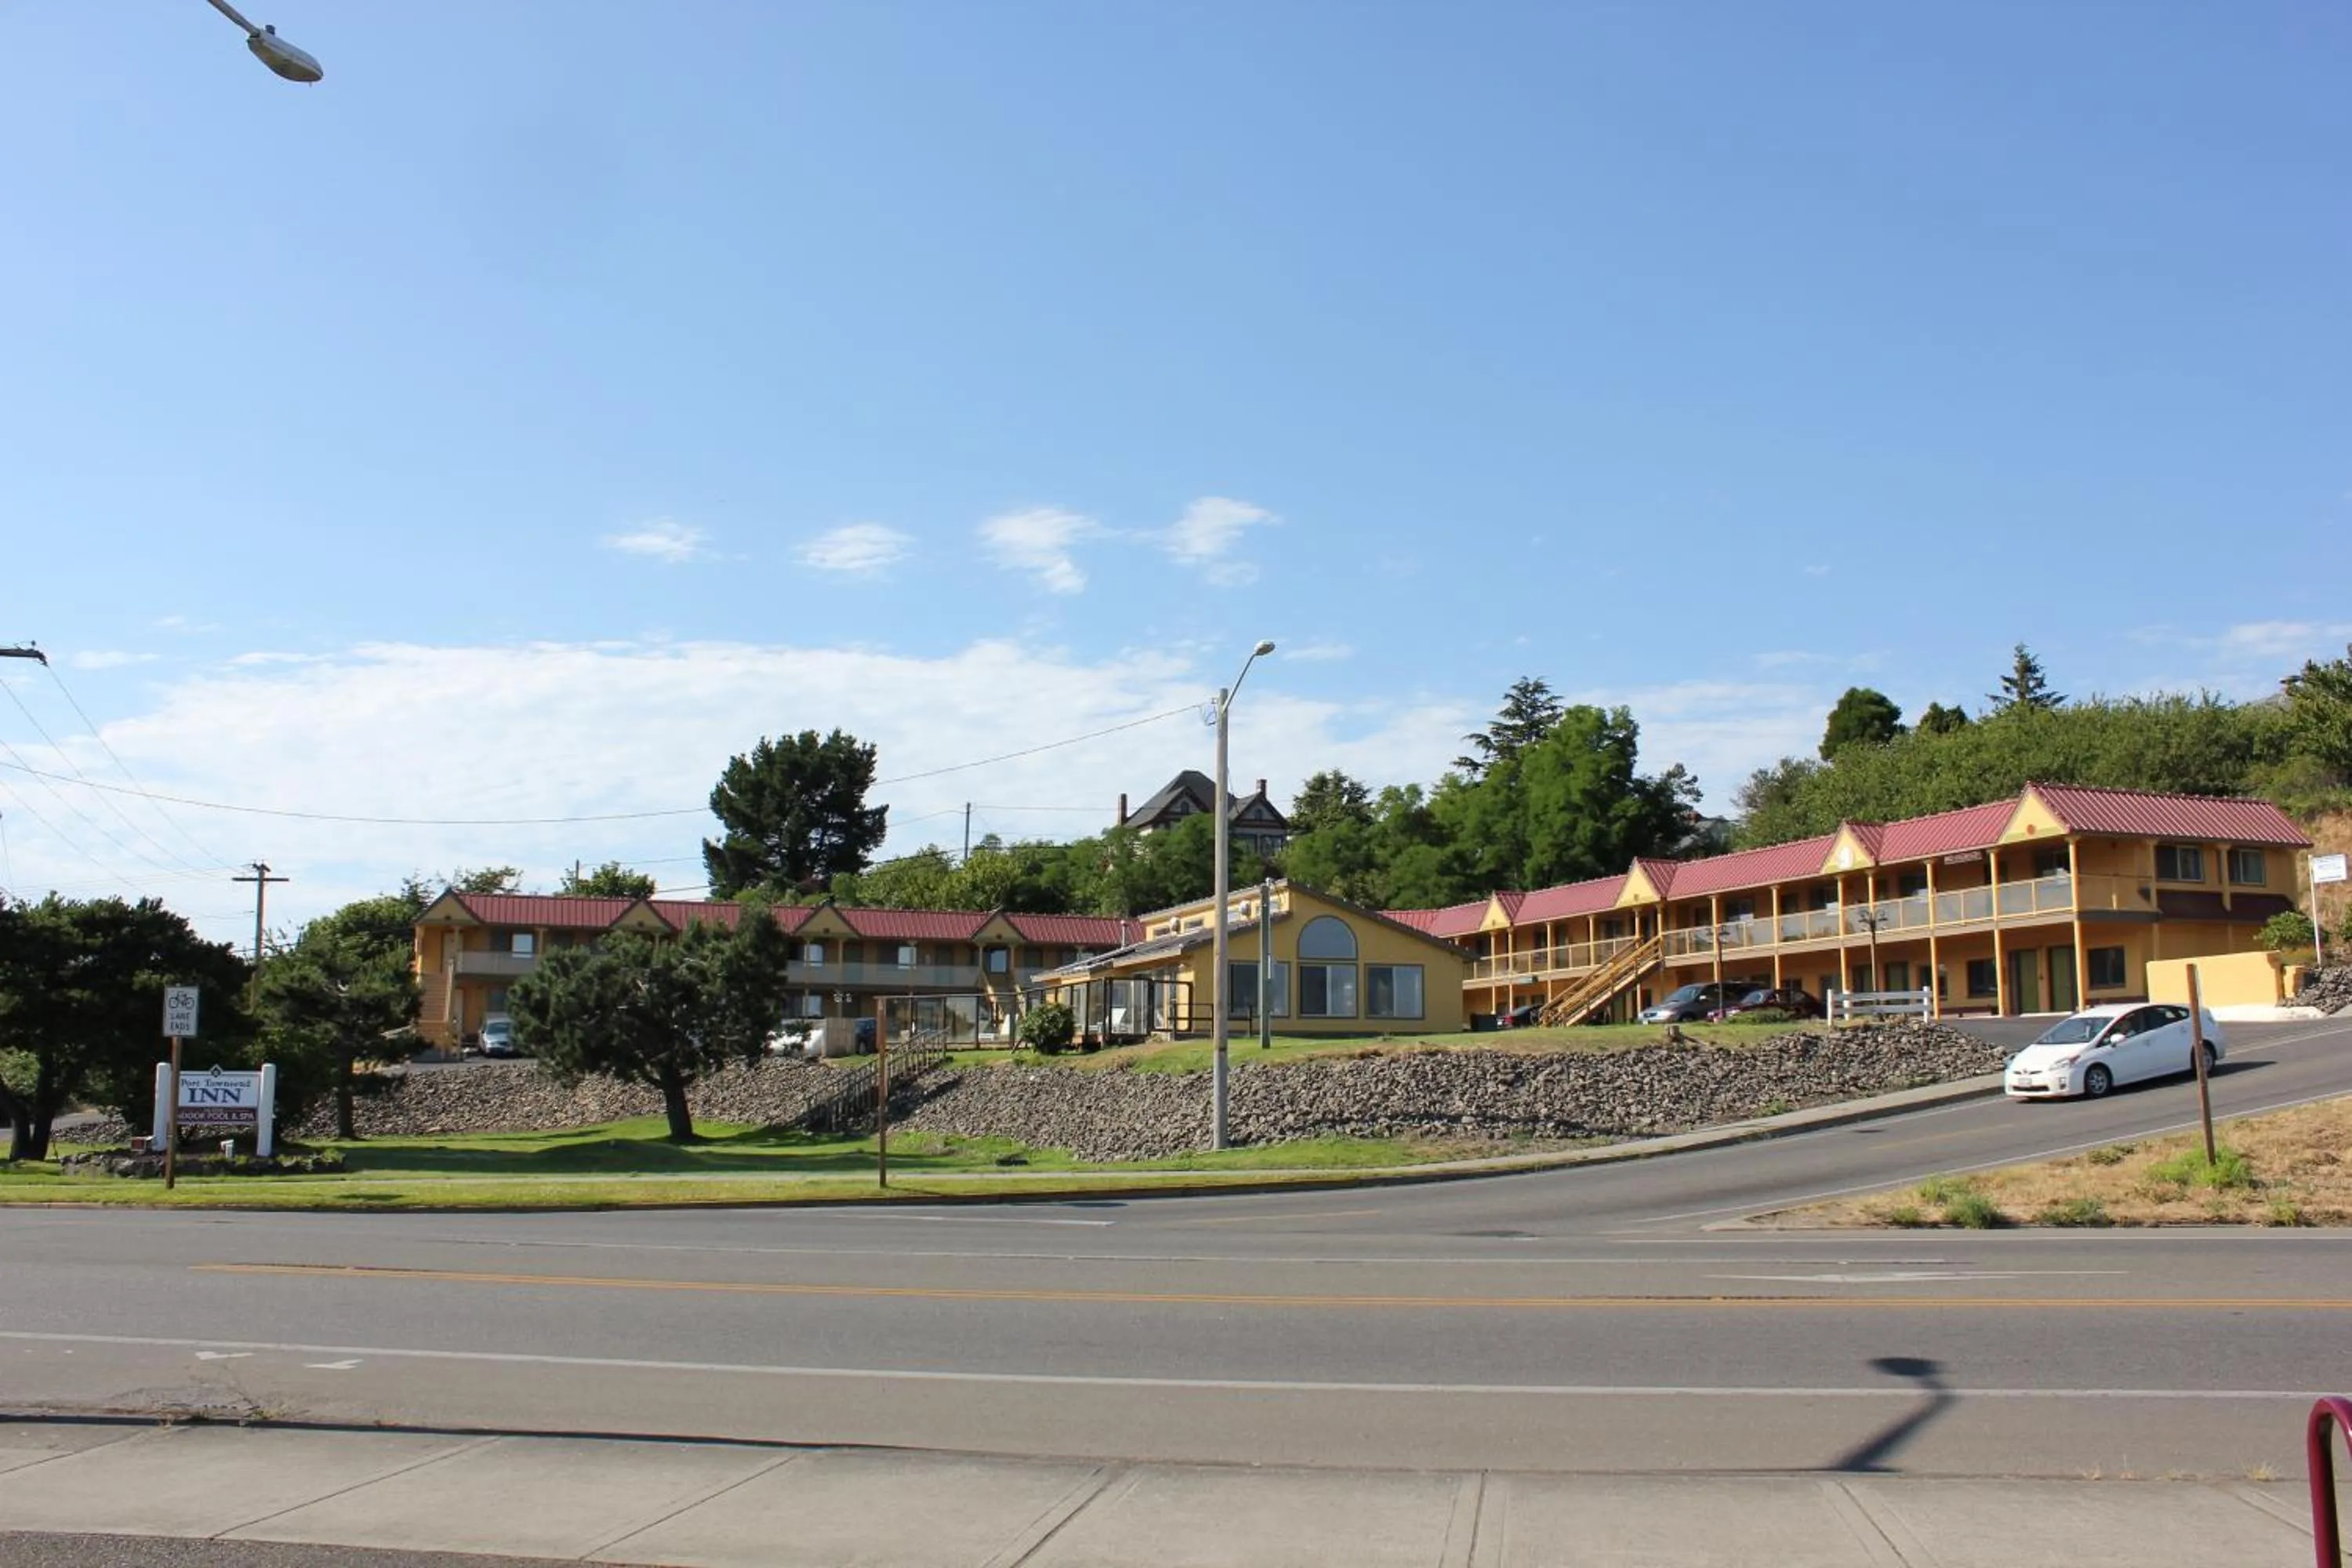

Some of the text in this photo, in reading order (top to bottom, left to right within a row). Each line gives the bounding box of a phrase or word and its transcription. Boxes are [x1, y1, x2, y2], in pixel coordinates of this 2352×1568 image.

[170, 1022, 190, 1030] ENDS
[188, 1087, 242, 1103] INN
[207, 1112, 228, 1120] POOL
[240, 1112, 255, 1121] SPA
